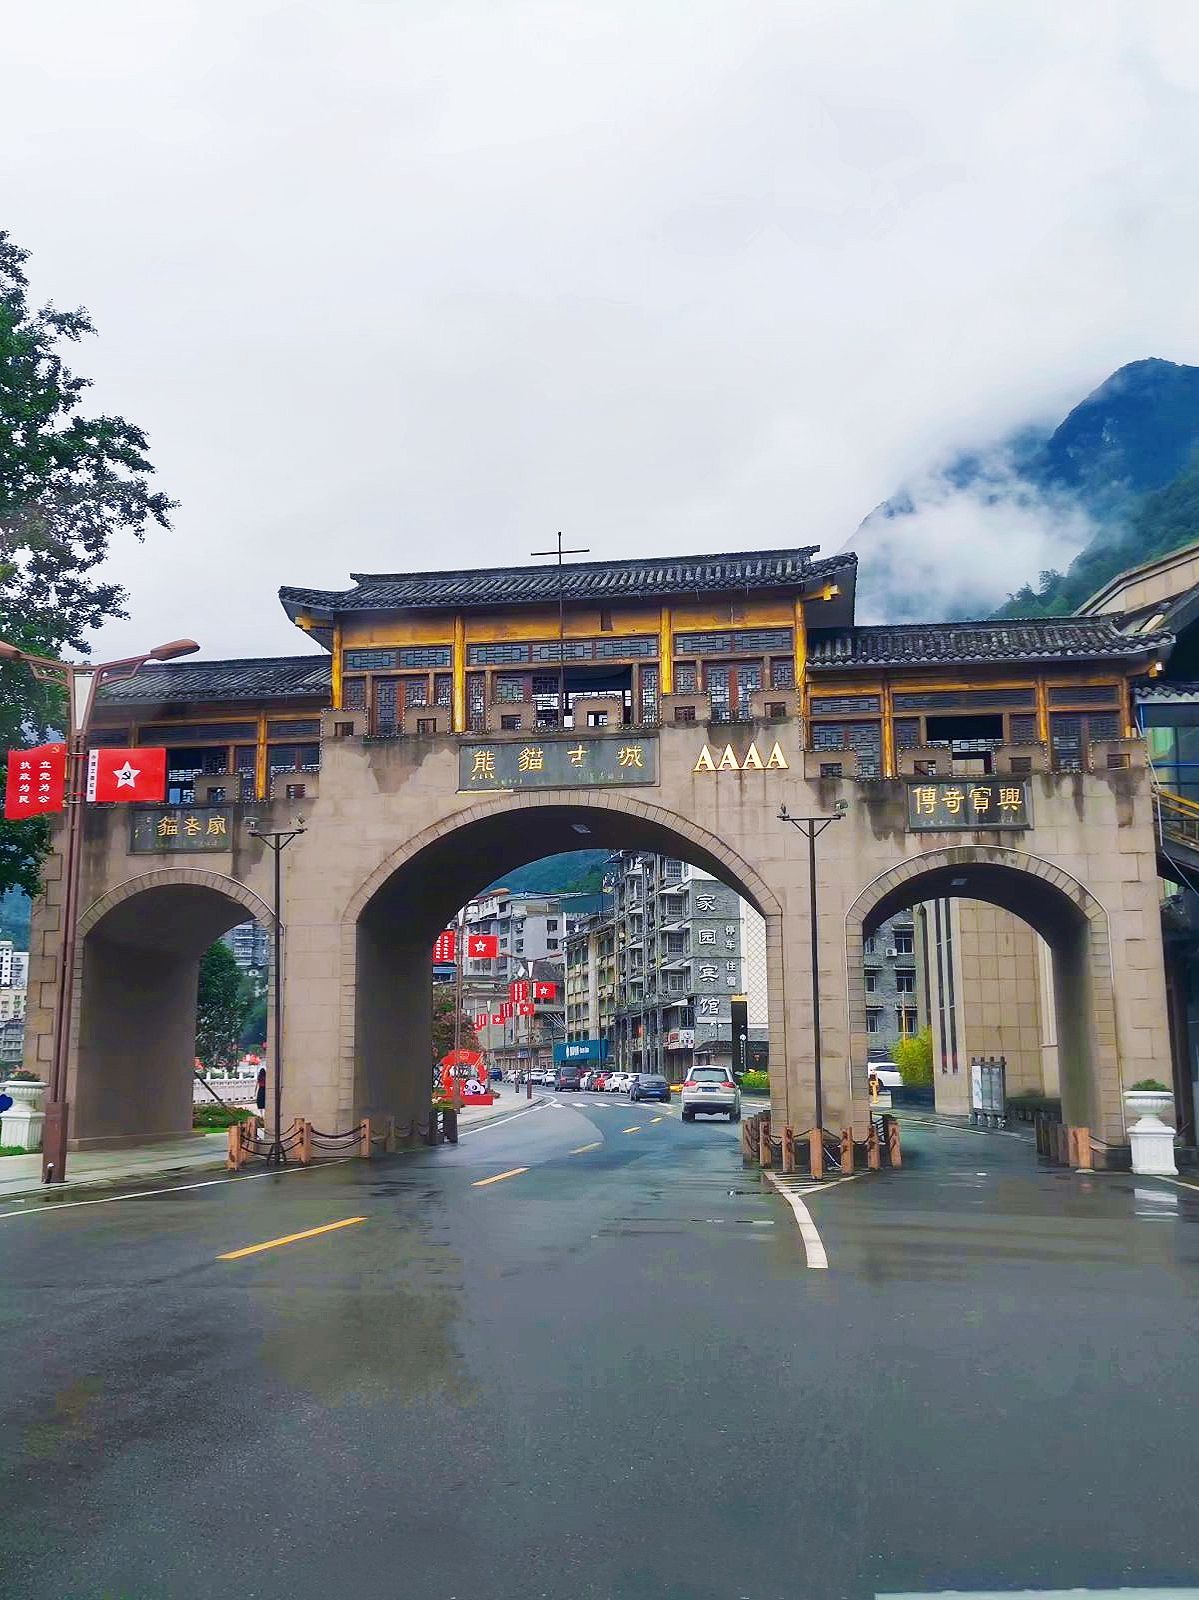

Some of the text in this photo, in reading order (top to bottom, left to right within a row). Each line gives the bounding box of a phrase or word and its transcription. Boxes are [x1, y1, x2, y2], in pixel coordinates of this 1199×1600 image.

[693, 742, 789, 771] AAAA
[18, 761, 31, 804] 执政为民
[38, 760, 52, 803] 立党为公
[695, 893, 721, 1016] 家园宾馆
